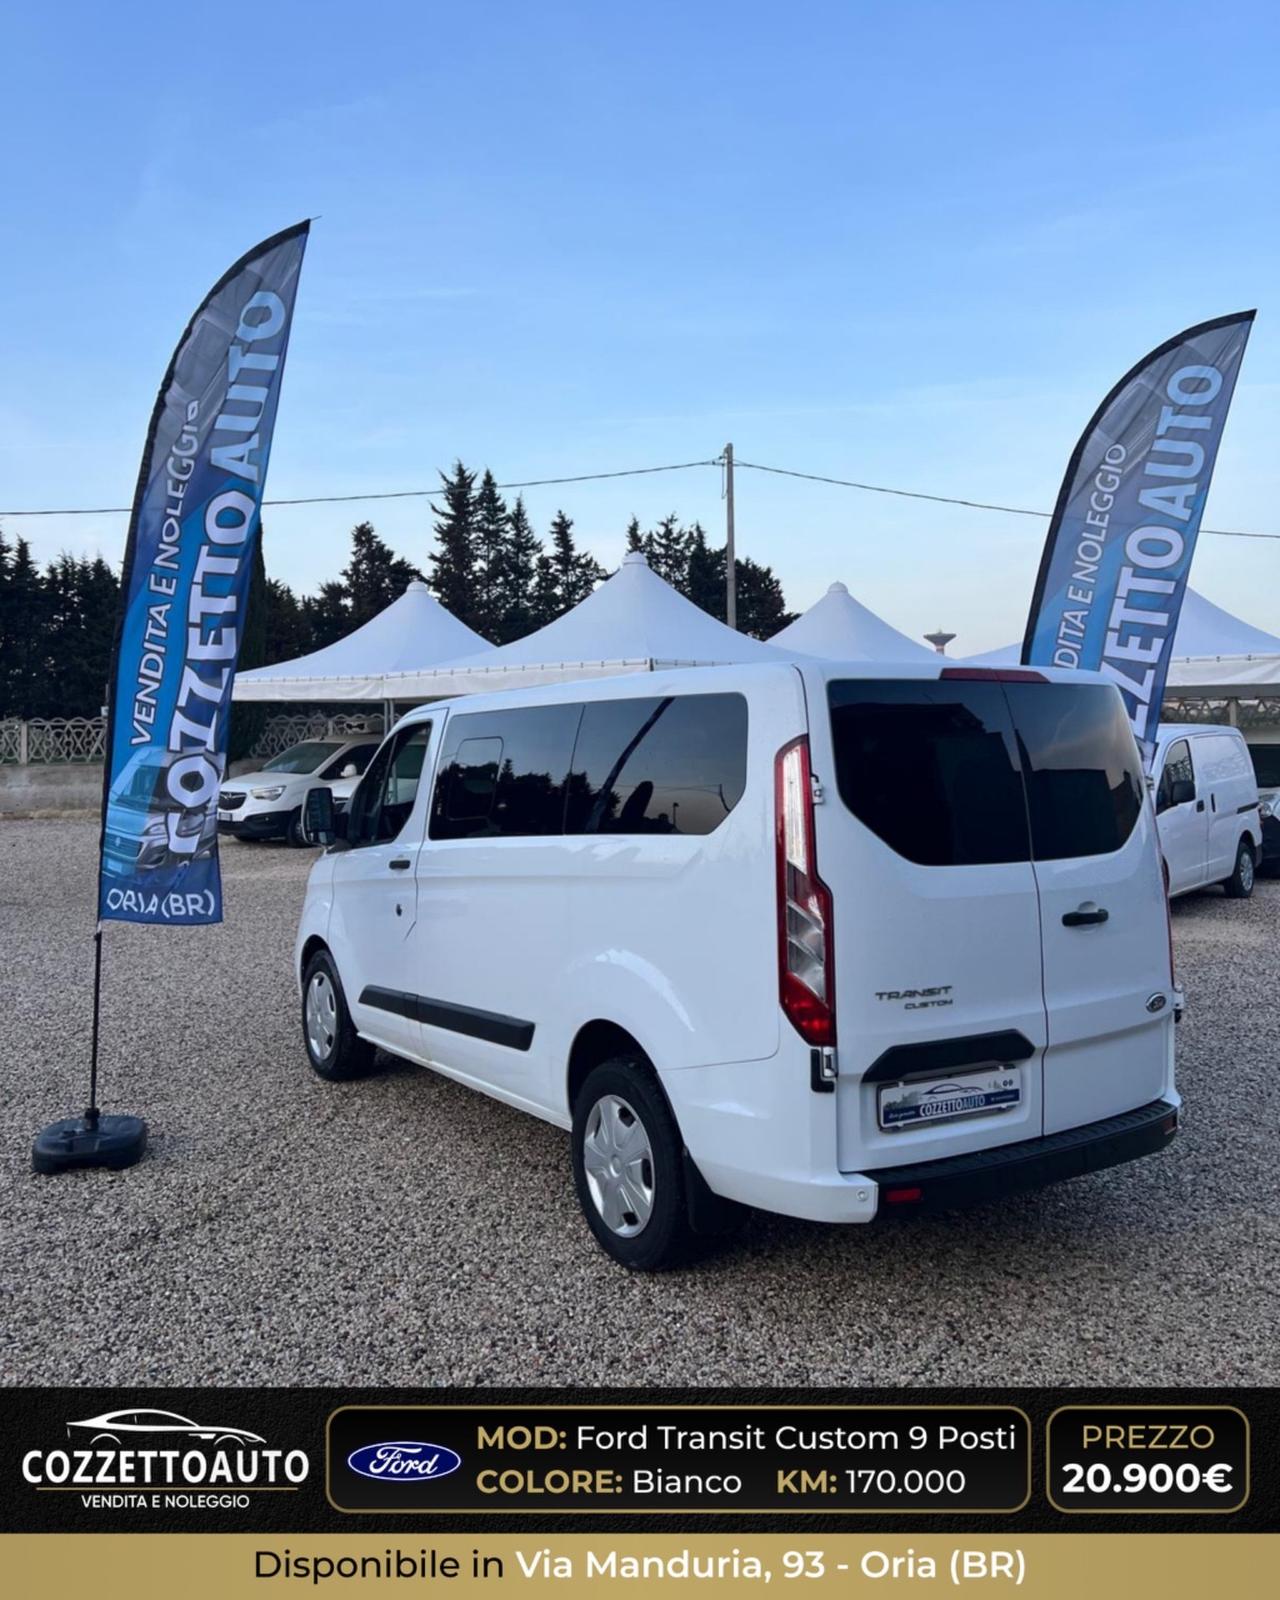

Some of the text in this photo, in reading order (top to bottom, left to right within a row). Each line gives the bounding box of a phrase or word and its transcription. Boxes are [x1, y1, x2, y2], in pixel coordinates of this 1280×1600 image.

[1053, 443, 1127, 670] DITA E NOLEGGIO
[130, 399, 199, 745] VENDITA E NOLEGGIO
[875, 985, 953, 1001] TRANSIT
[904, 998, 953, 1010] CUSTOM
[919, 1095, 986, 1117] COZZETTOAUTO
